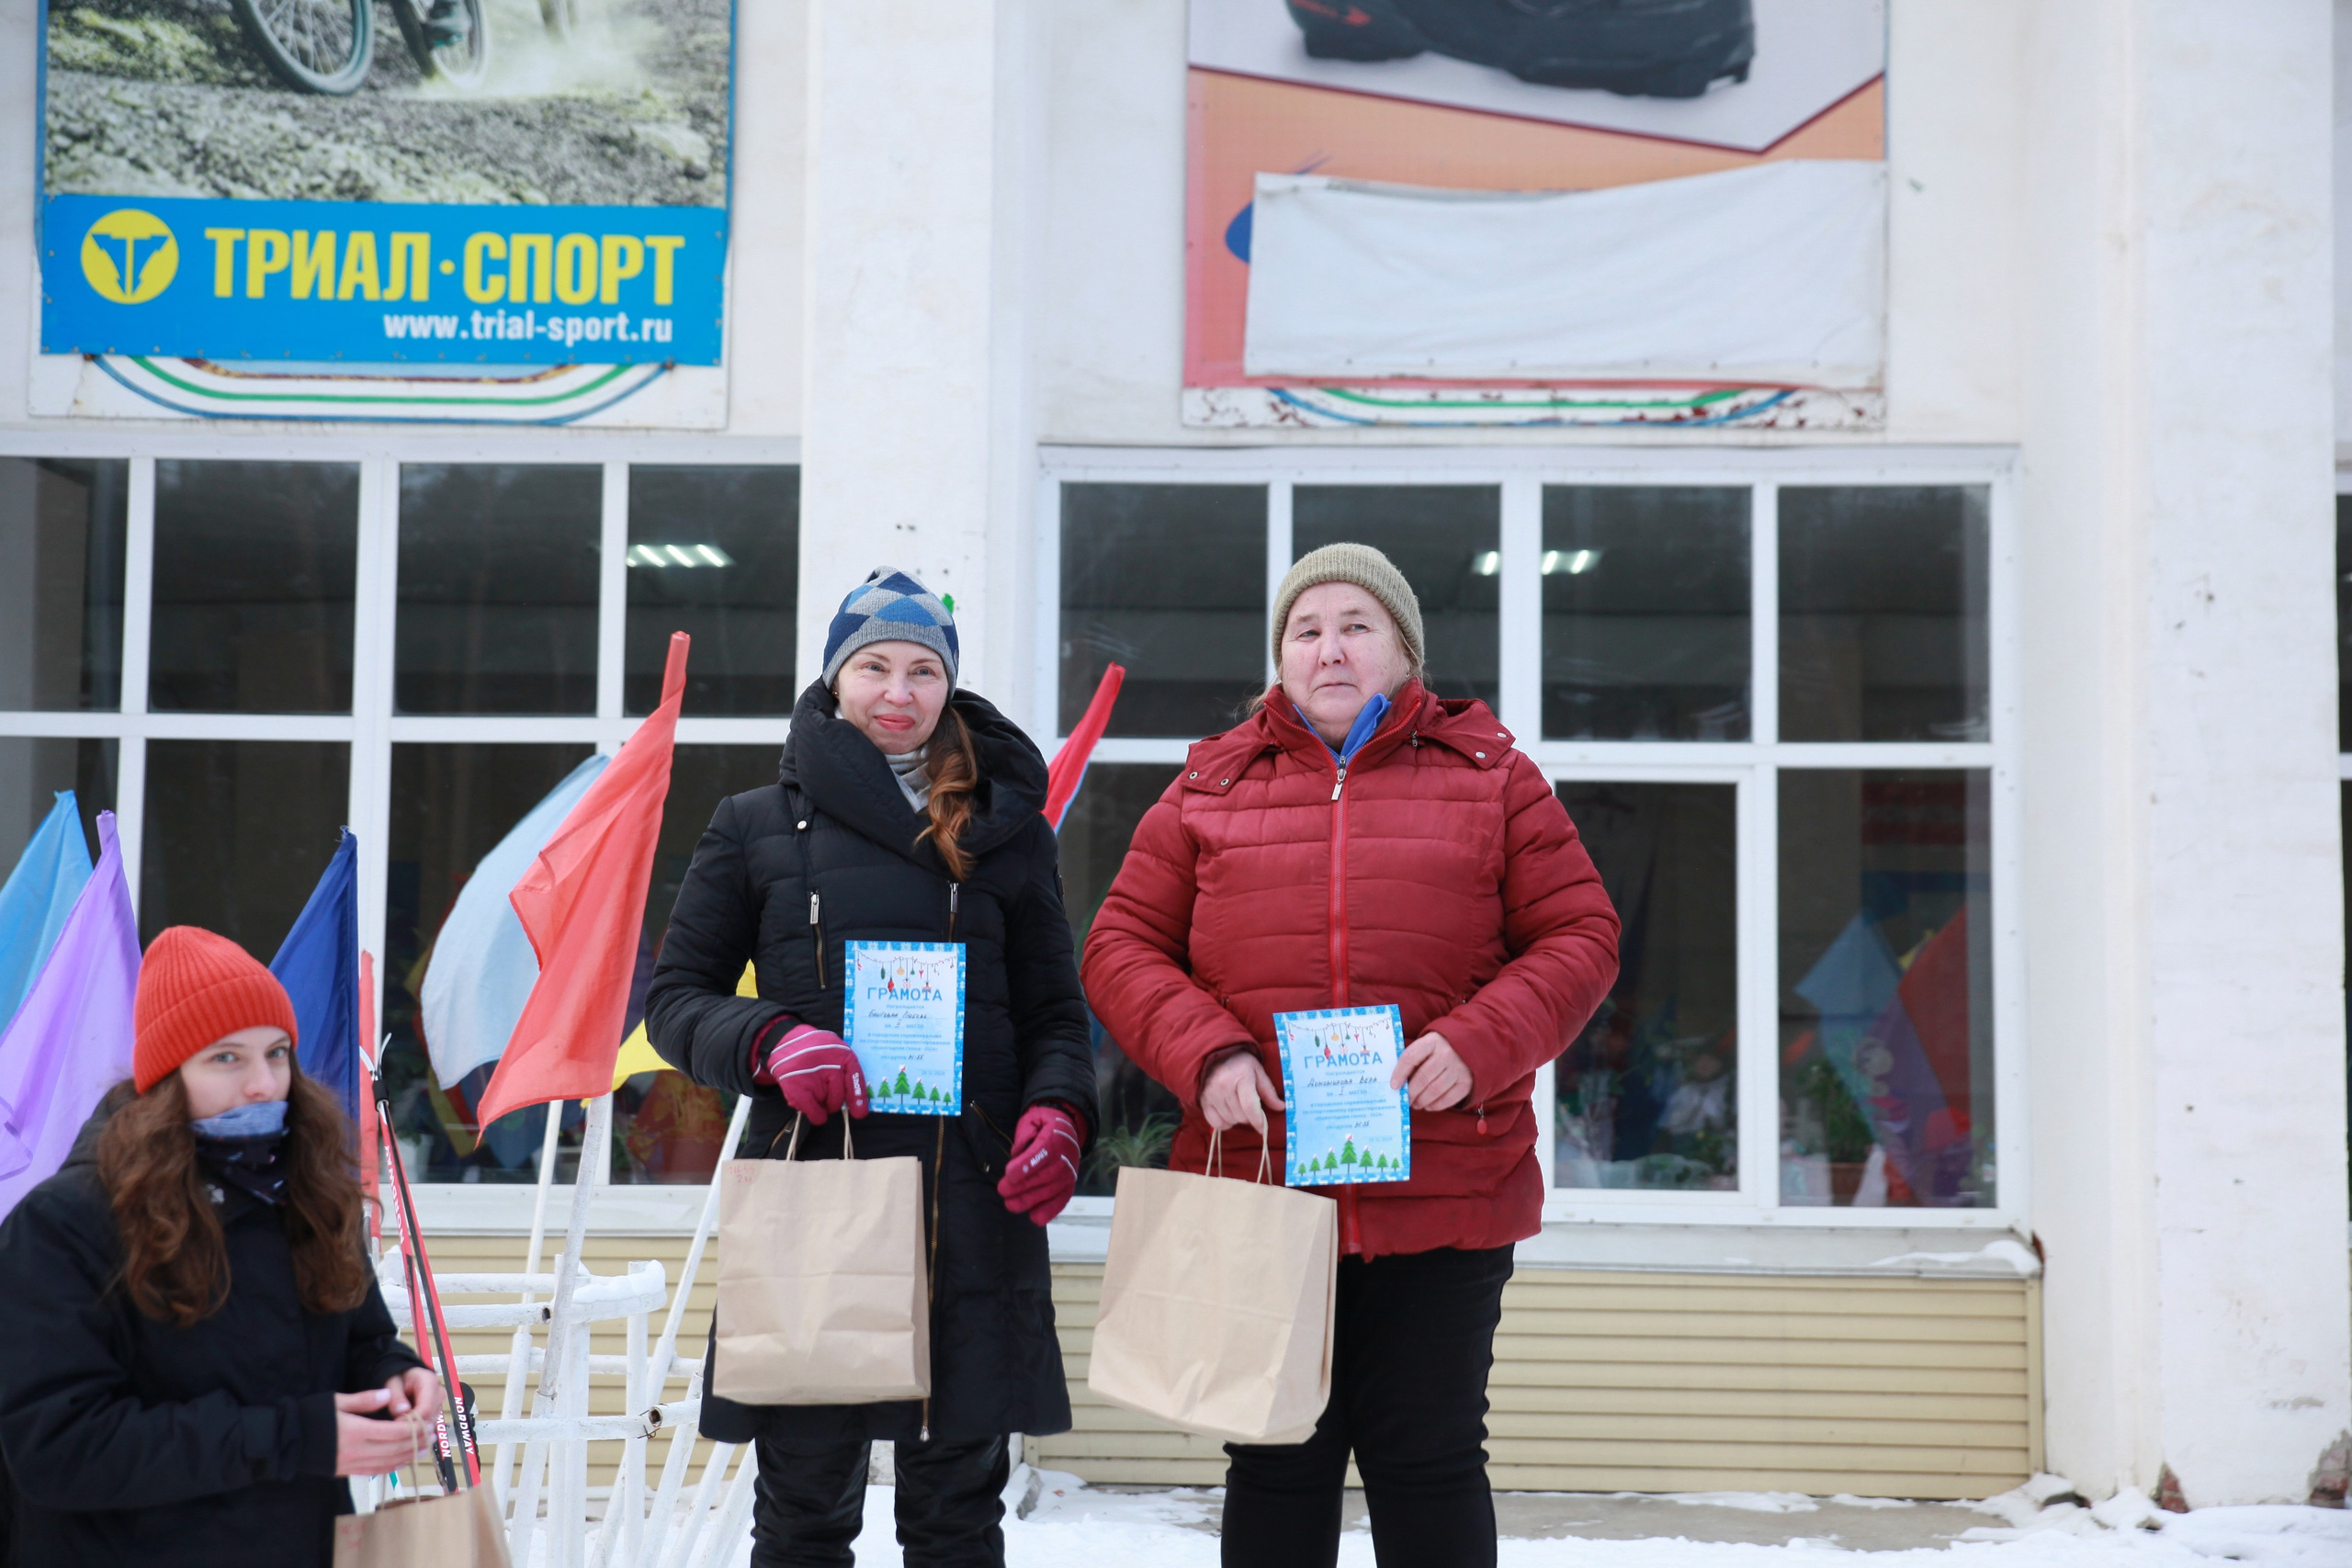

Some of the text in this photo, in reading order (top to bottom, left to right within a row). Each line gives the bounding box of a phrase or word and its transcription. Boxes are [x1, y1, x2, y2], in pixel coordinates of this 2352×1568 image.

[384, 310, 673, 350] www.trial-sport.ru
[866, 987, 943, 1001] ГРАМОТА
[1304, 1051, 1383, 1068] ГРАМОТА
[384, 1145, 405, 1244] NORDWAY
[436, 1407, 452, 1458] NORDW
[454, 1396, 475, 1455] NORDWAY
